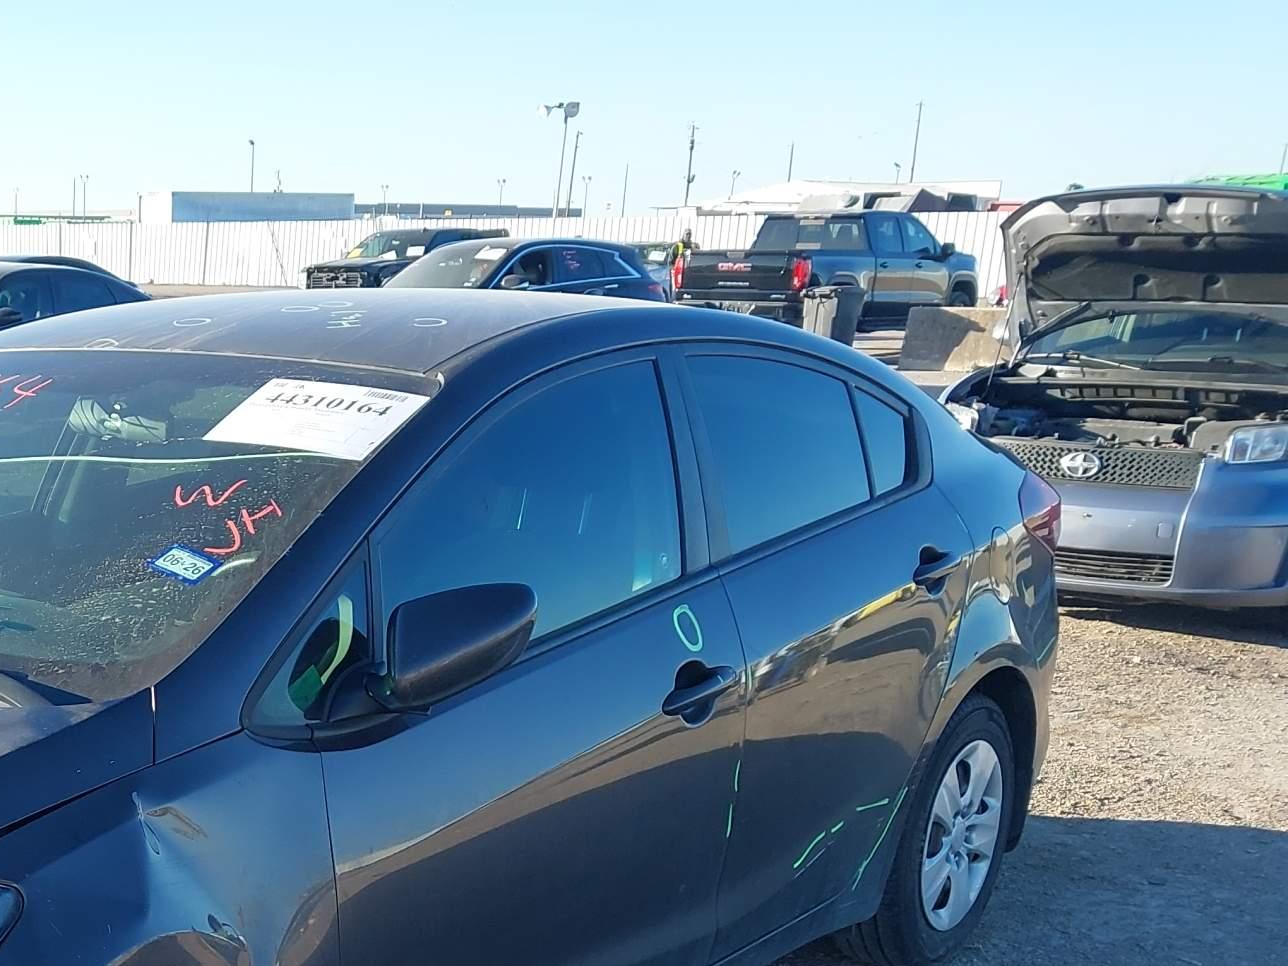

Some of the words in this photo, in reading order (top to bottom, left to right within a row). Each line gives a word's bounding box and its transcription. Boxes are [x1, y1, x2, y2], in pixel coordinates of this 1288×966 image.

[718, 262, 752, 272] GMC
[265, 392, 394, 417] 44310164
[163, 553, 184, 566] 06
[182, 562, 206, 575] 26
